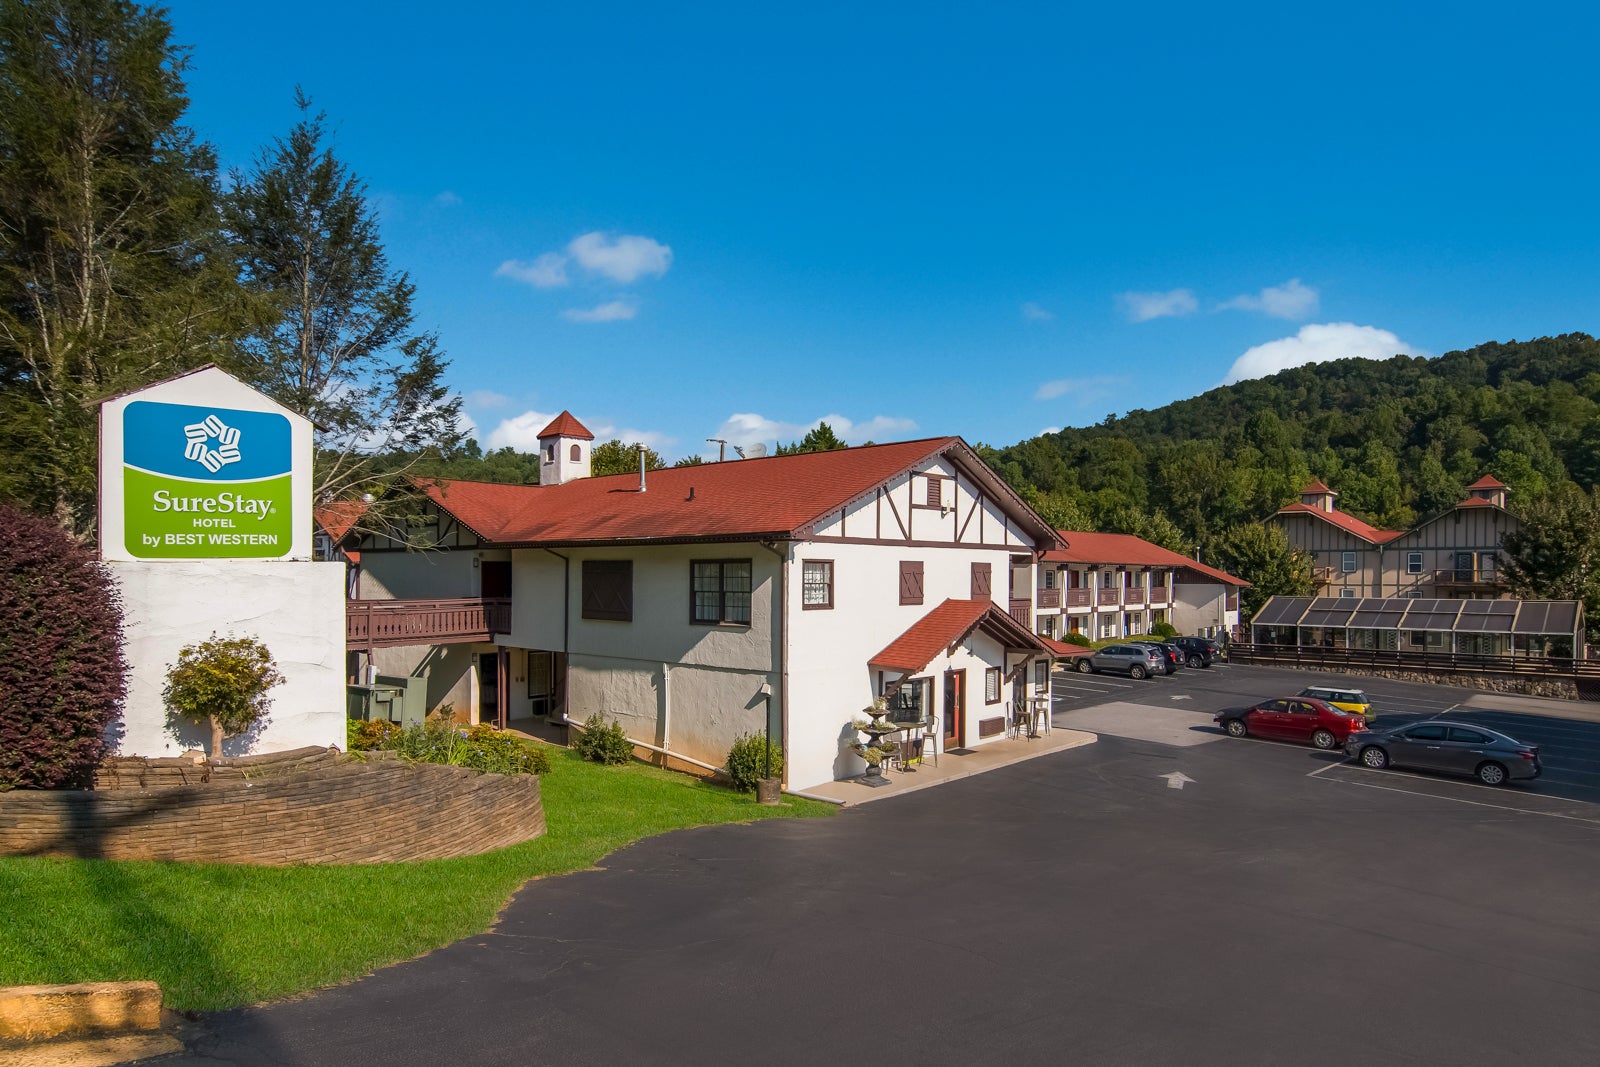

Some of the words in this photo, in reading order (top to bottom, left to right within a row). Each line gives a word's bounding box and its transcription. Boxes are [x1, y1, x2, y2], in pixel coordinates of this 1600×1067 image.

[193, 518, 236, 528] HOTEL
[142, 533, 161, 548] by
[165, 533, 205, 545] BEST
[209, 533, 278, 545] WESTERN
